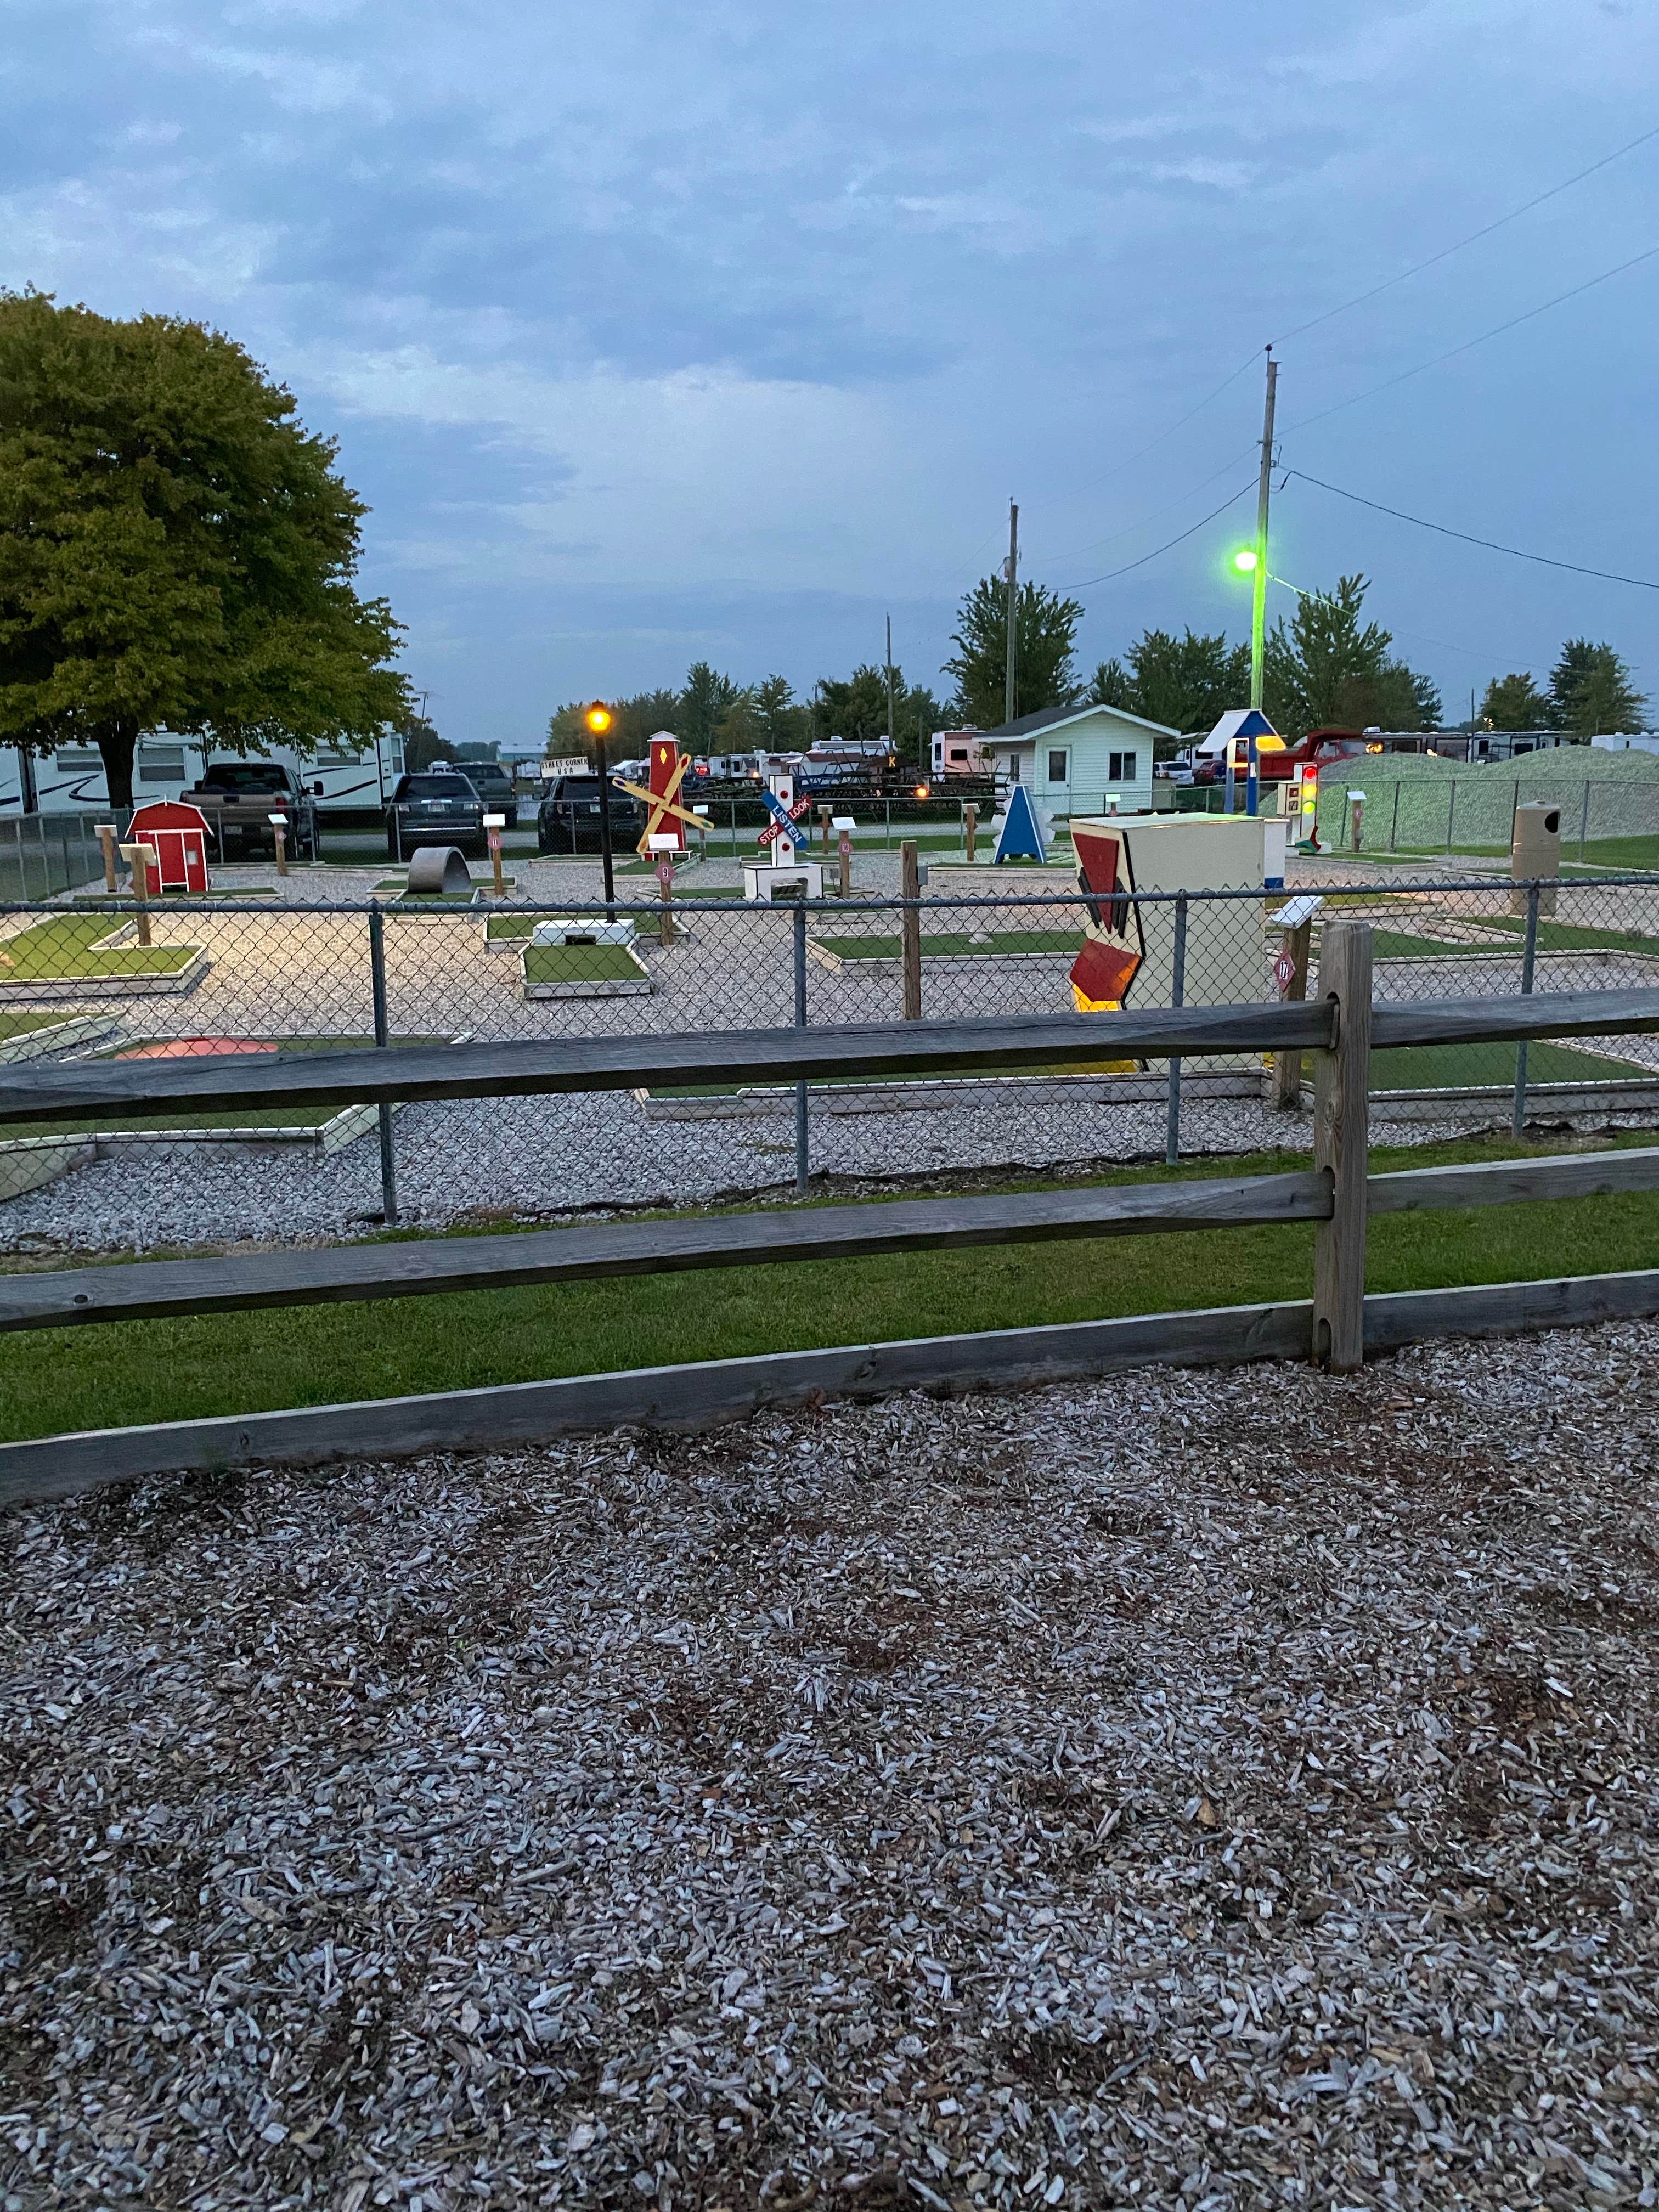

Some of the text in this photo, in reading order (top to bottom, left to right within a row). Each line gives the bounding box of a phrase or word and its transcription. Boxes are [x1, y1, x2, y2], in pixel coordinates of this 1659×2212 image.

[541, 758, 588, 769] STREET CORNER
[889, 756, 895, 767] K
[789, 798, 810, 819] LOOK
[772, 805, 802, 843] LISTEN
[759, 825, 778, 844] STOP
[663, 868, 668, 877] 9
